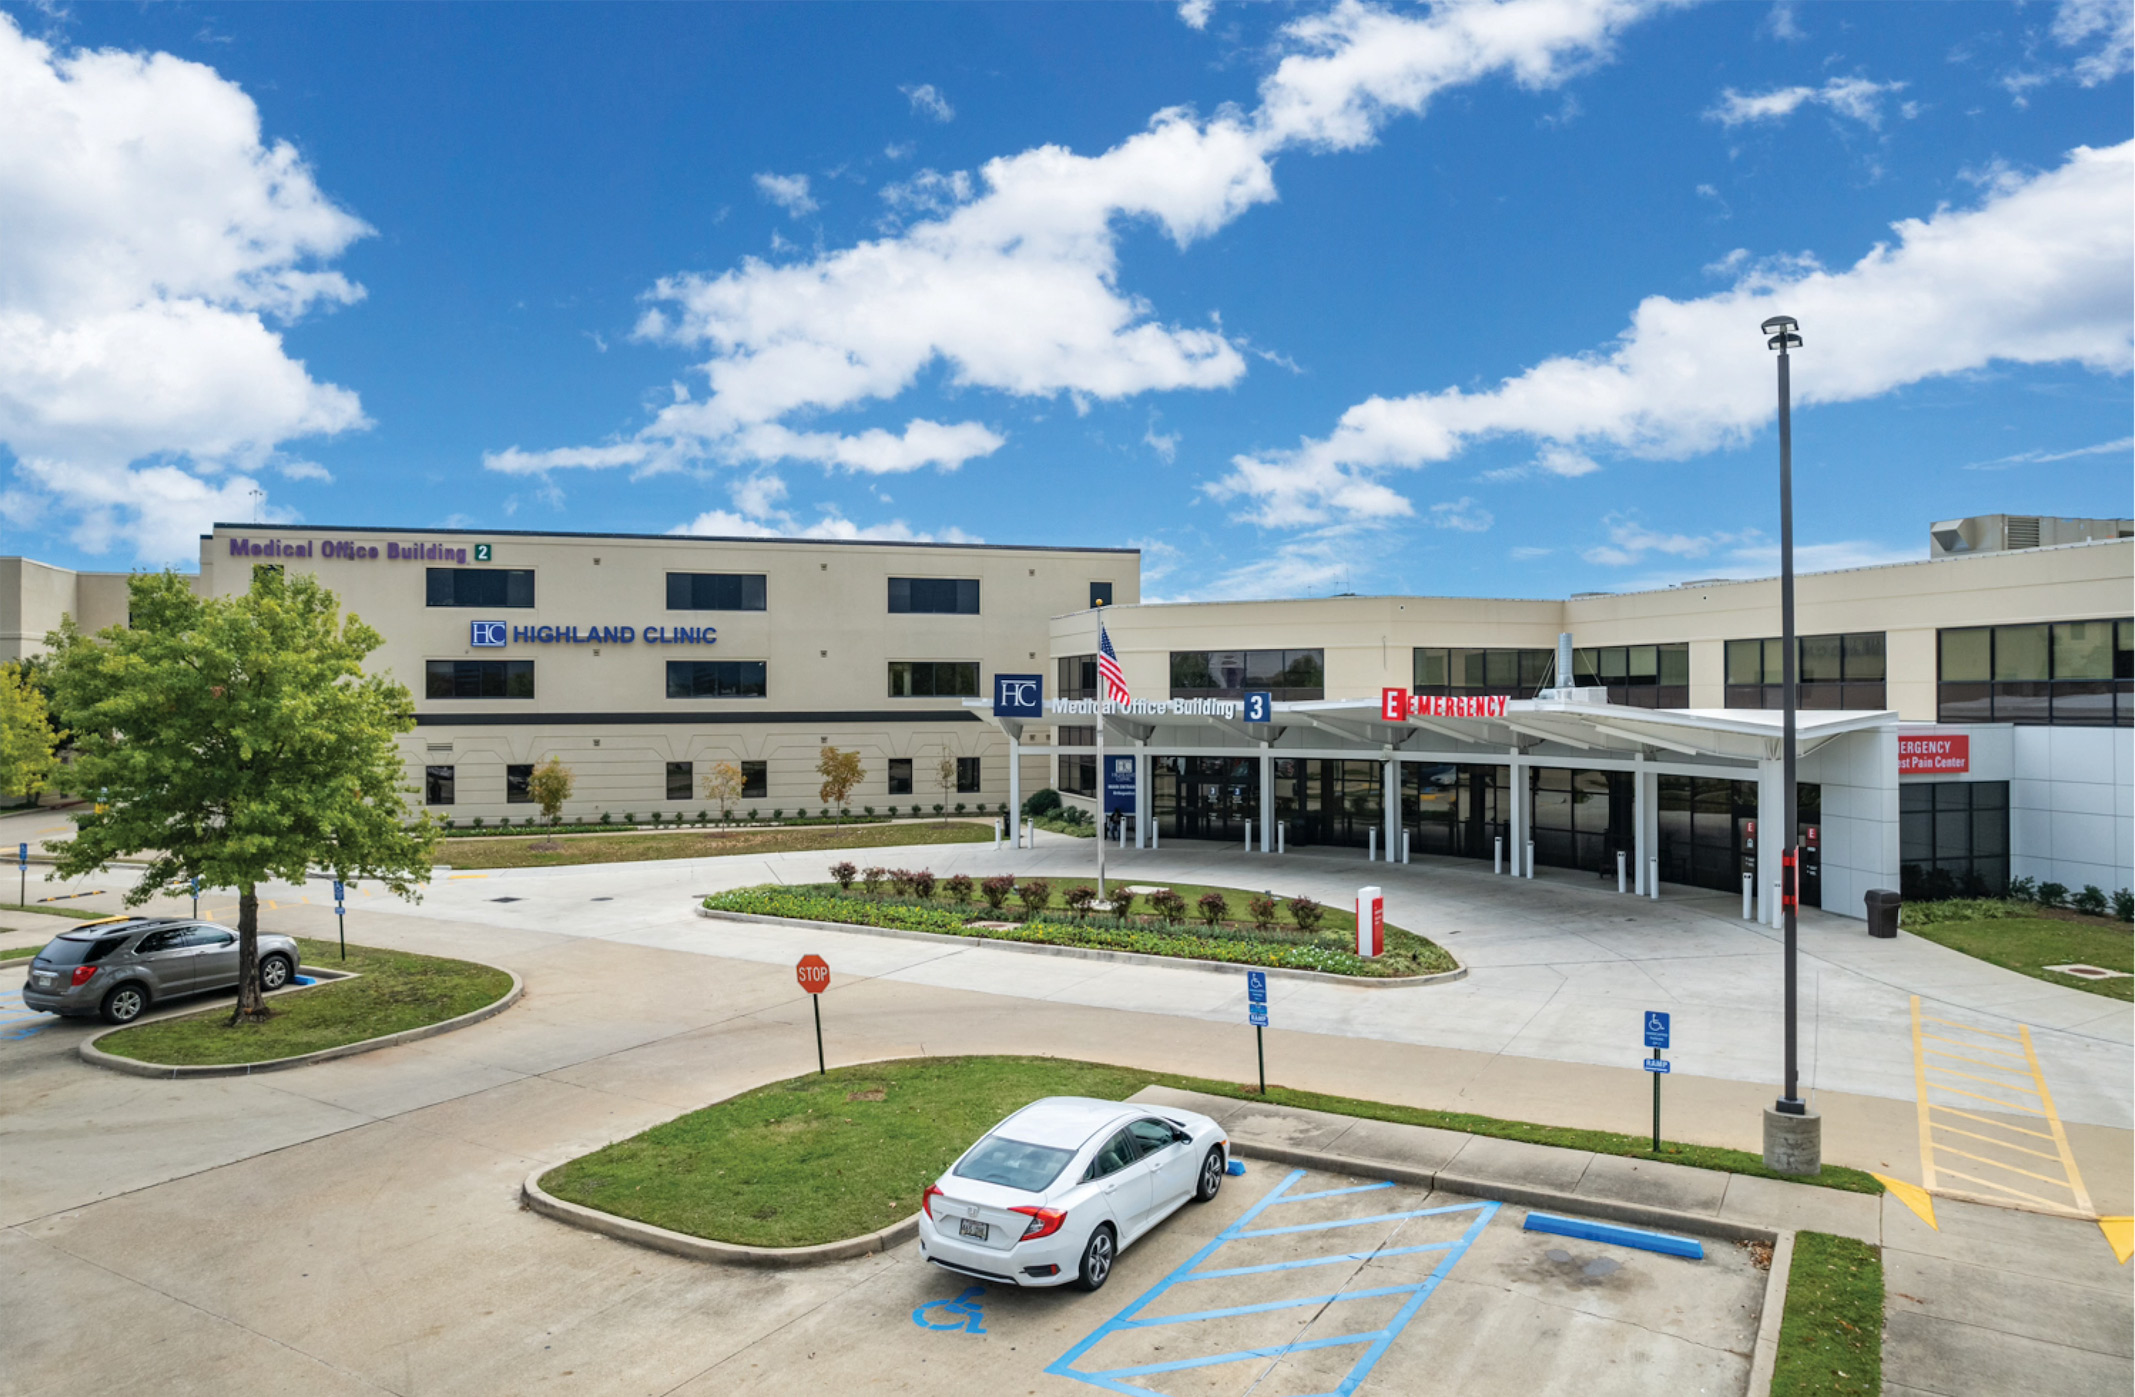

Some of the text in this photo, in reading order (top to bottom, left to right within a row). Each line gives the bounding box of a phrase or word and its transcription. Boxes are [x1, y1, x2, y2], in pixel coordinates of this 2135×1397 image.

[230, 538, 488, 564] Medical Office Building 2
[473, 623, 717, 644] HC HIGHLAND CLINIC
[1000, 683, 1037, 707] HC
[1387, 691, 1509, 718] E EMERGENCY
[1052, 697, 1115, 714] Medical
[1173, 697, 1235, 720] Building
[1250, 695, 1263, 720] 3
[1900, 741, 1951, 754] ERGENCY
[1912, 756, 1933, 768] Pain
[1935, 756, 1966, 768] Center
[799, 966, 828, 982] STOP
[1646, 1060, 1668, 1068] RAMP
